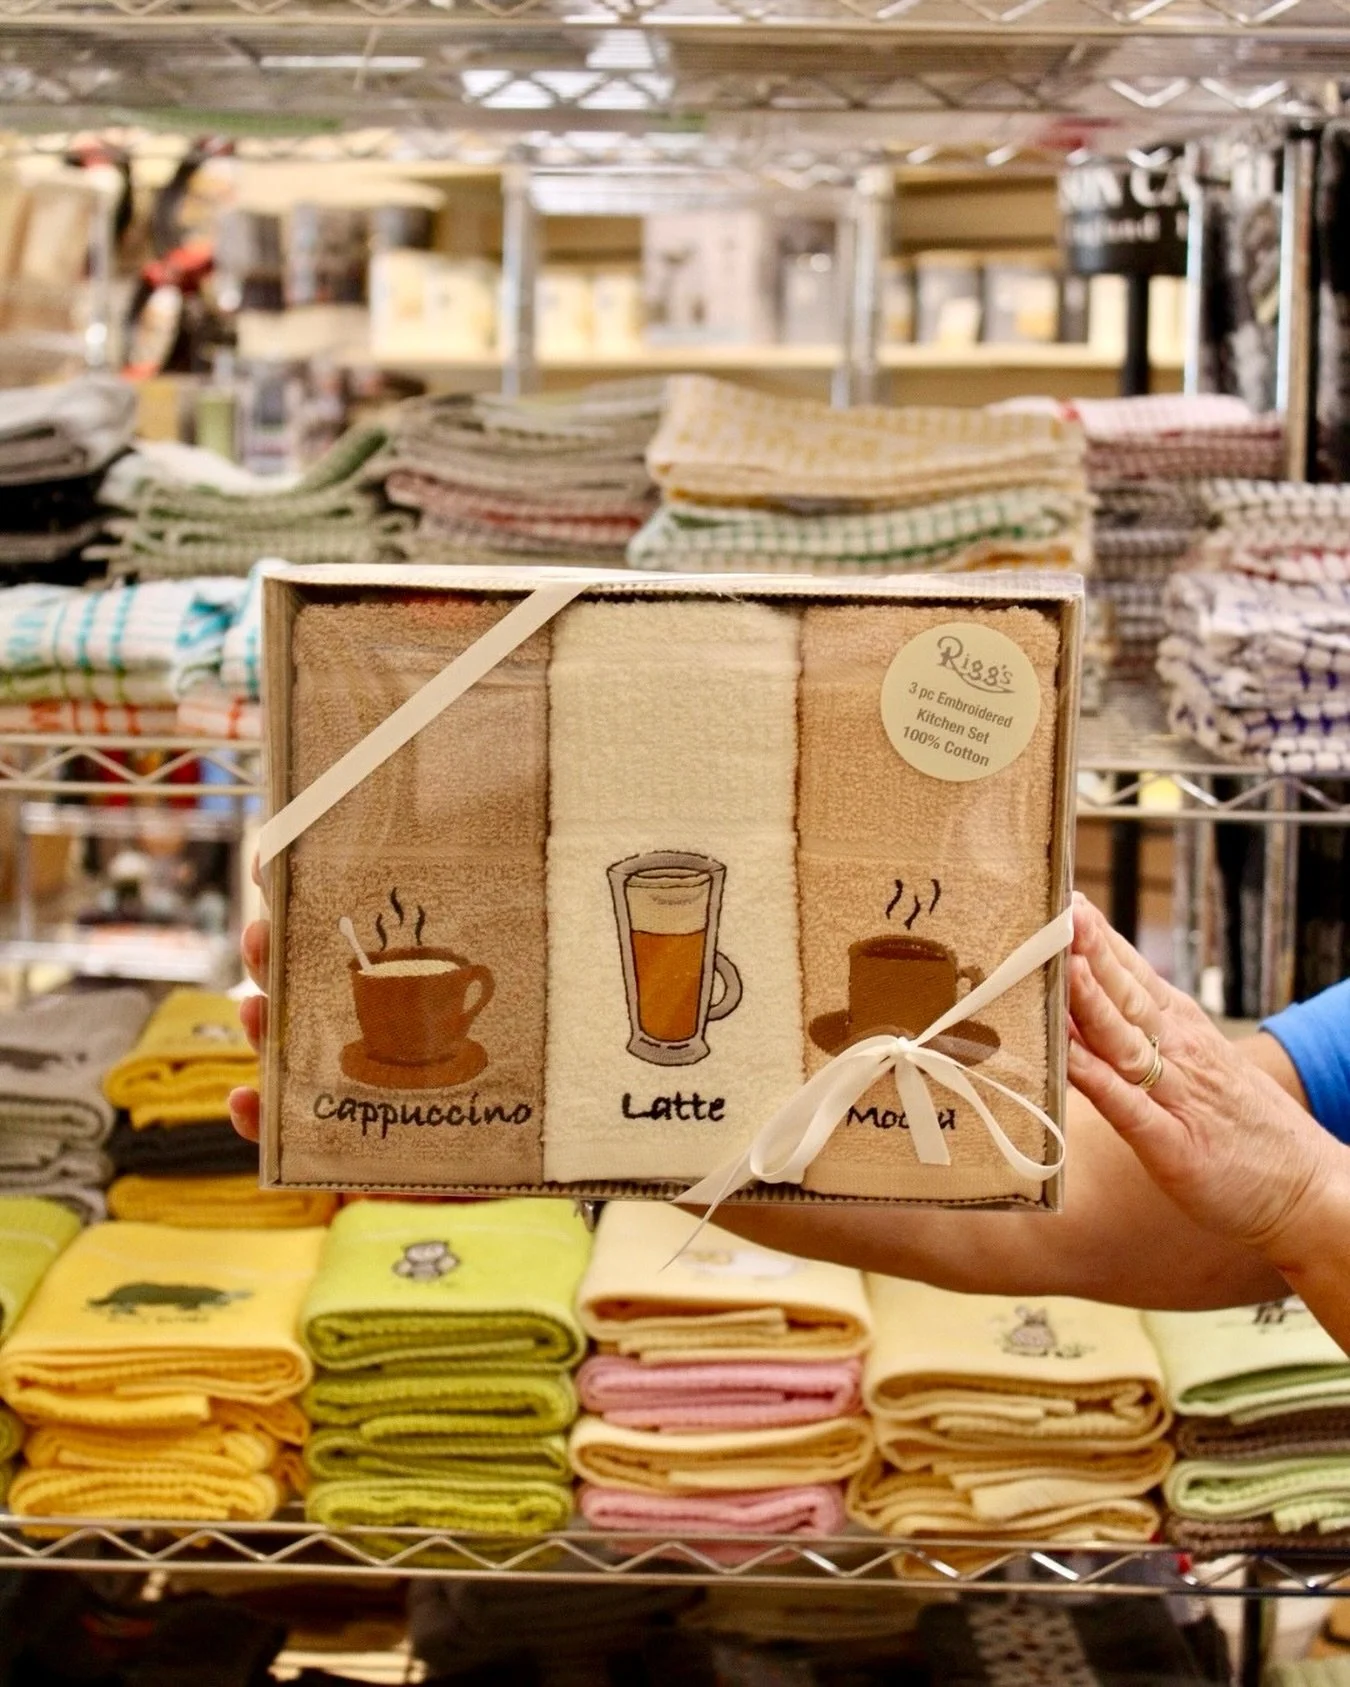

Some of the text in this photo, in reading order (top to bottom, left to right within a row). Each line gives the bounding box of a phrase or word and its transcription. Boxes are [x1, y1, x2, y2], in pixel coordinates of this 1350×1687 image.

[936, 635, 1015, 693] Rigg's
[908, 681, 1013, 729] 3 pc Embroidered
[903, 725, 989, 767] 100% Cotton
[916, 708, 990, 745] Kitchen Set
[313, 1091, 532, 1139] Cappuccino
[621, 1092, 727, 1121] Latte
[846, 1105, 956, 1130] Moca
